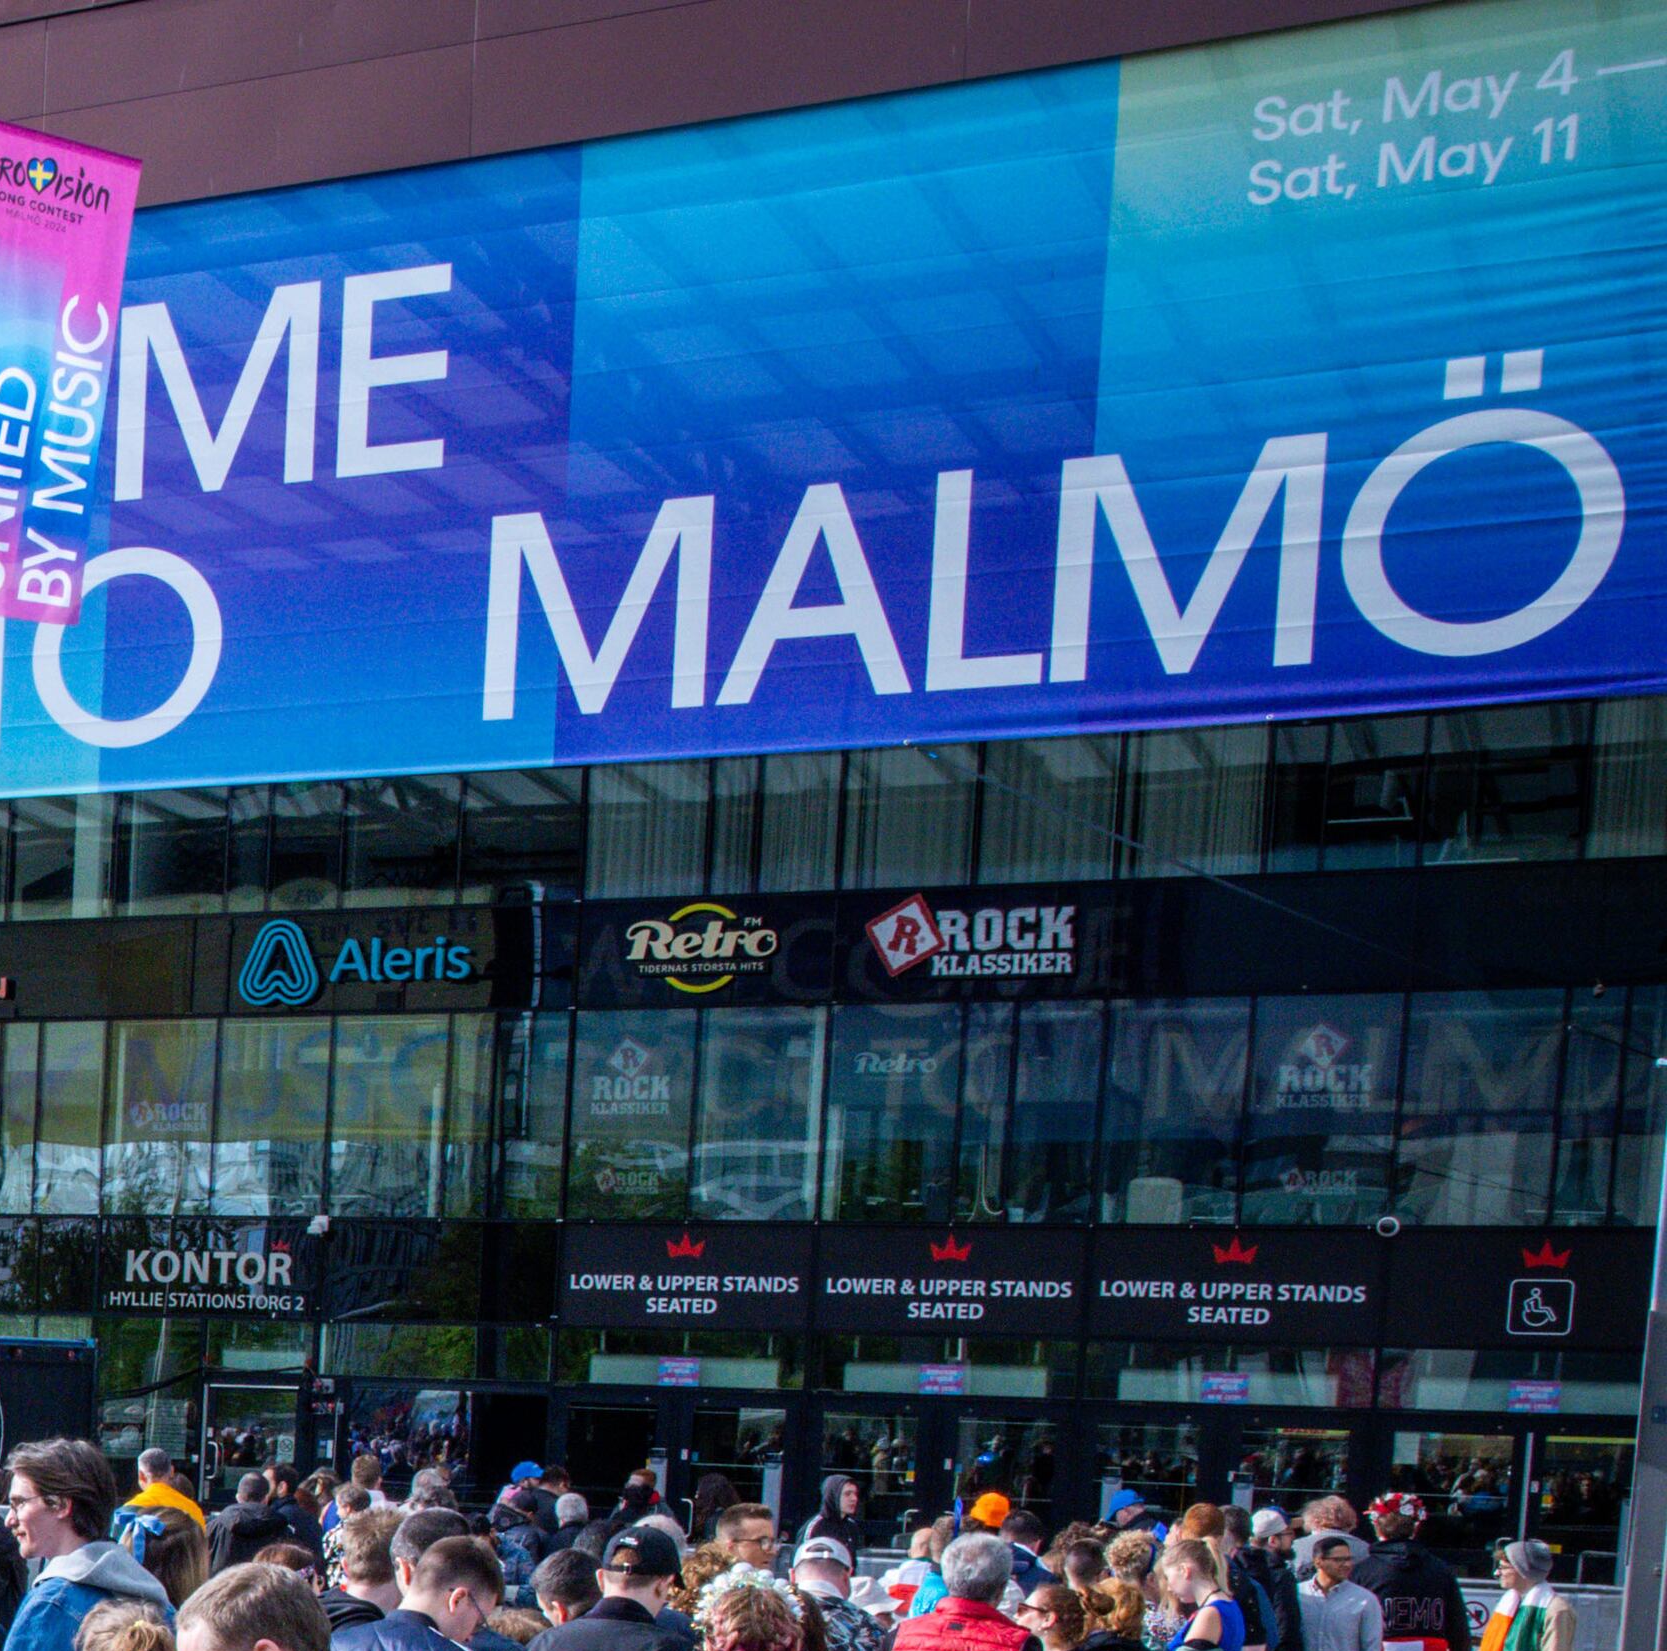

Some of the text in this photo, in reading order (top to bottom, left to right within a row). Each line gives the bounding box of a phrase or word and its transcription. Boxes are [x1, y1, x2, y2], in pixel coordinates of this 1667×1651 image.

[1251, 88, 1362, 142] Sat,
[1382, 70, 1521, 124] May
[1536, 49, 1580, 96] 4
[1245, 113, 1580, 202] Sat, May 11
[29, 200, 84, 225] CONTEST
[16, 294, 110, 609] BY MUSIC
[481, 347, 1627, 722] MALMÖ
[743, 916, 763, 927] FM
[935, 905, 1076, 951] ROCK
[625, 919, 778, 960] Retro
[329, 935, 470, 984] Aleris
[638, 963, 689, 974] TIDERNAS
[740, 961, 764, 971] HITS
[931, 952, 1073, 977] KLASSIKER
[853, 1051, 937, 1074] Retro
[591, 1075, 670, 1100] ROCK
[1277, 1063, 1373, 1092] ROCK
[590, 1101, 670, 1115] KLASSIKER
[124, 1248, 293, 1287] KONTOR
[569, 1273, 800, 1295] LOWER & UPPER STANDS
[825, 1277, 1073, 1300] LOWER & UPPER STANDS
[1099, 1280, 1367, 1303] LOWER & UPPER STANDS
[109, 1291, 305, 1311] HYLLIE STATIONSTORG 2
[645, 1297, 718, 1315] SEATED
[907, 1301, 985, 1322] SEATED
[1186, 1306, 1271, 1326] SEATED
